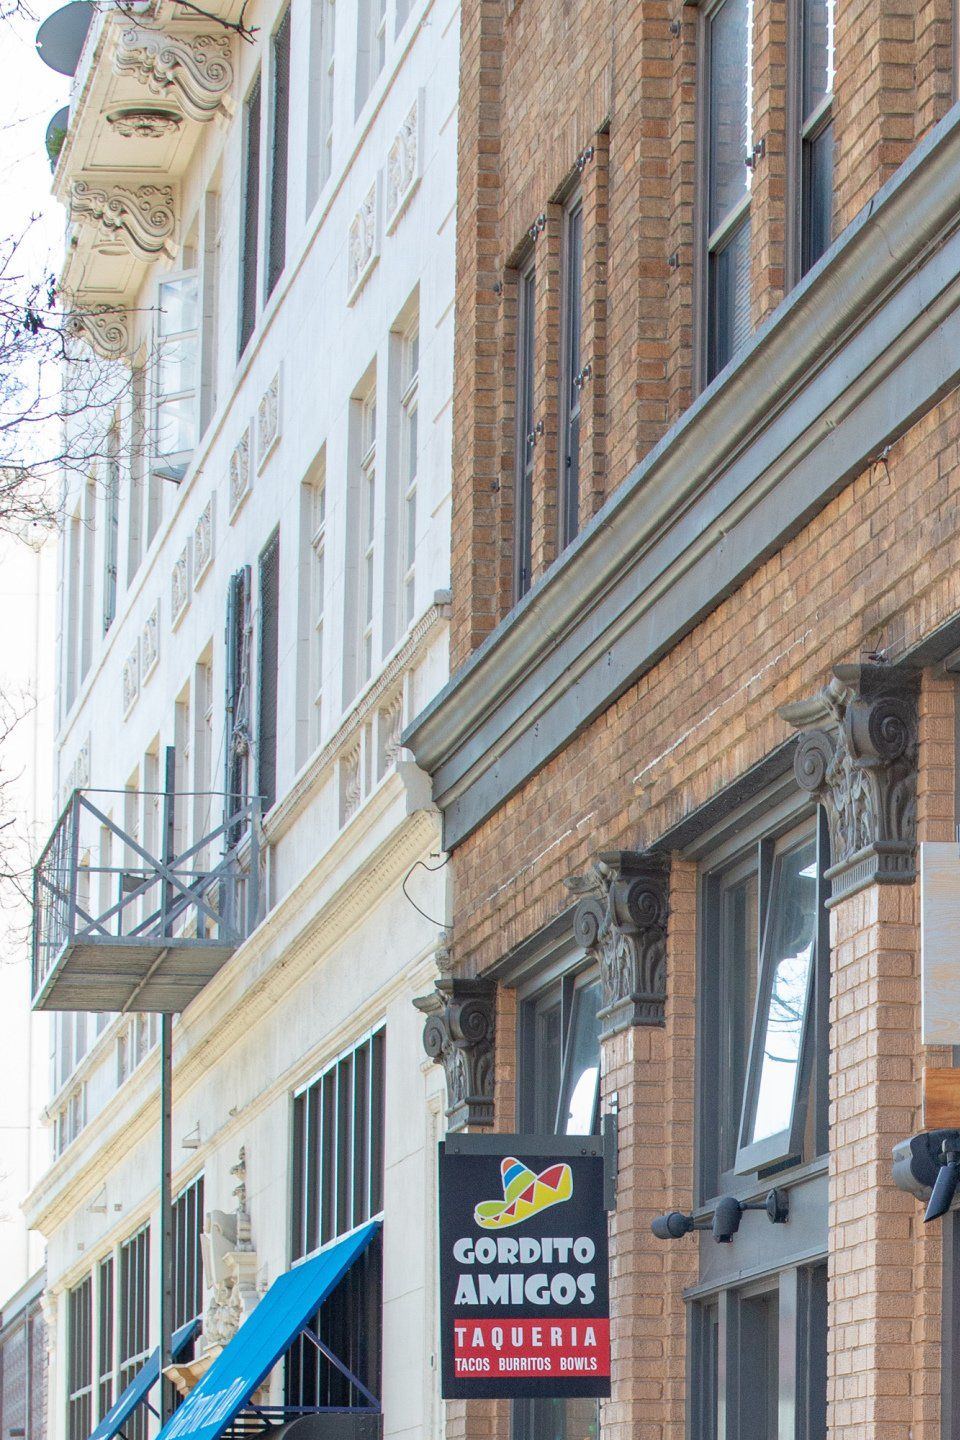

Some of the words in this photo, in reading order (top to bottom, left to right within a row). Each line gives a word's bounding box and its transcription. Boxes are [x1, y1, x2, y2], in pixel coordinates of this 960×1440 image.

[453, 1236, 596, 1265] GORDITO
[454, 1272, 596, 1306] AMIGOS
[455, 1326, 597, 1350] TAQUERIA
[455, 1357, 490, 1372] TACOS
[499, 1357, 552, 1371] BURRITOS
[560, 1356, 598, 1371] BOWLS
